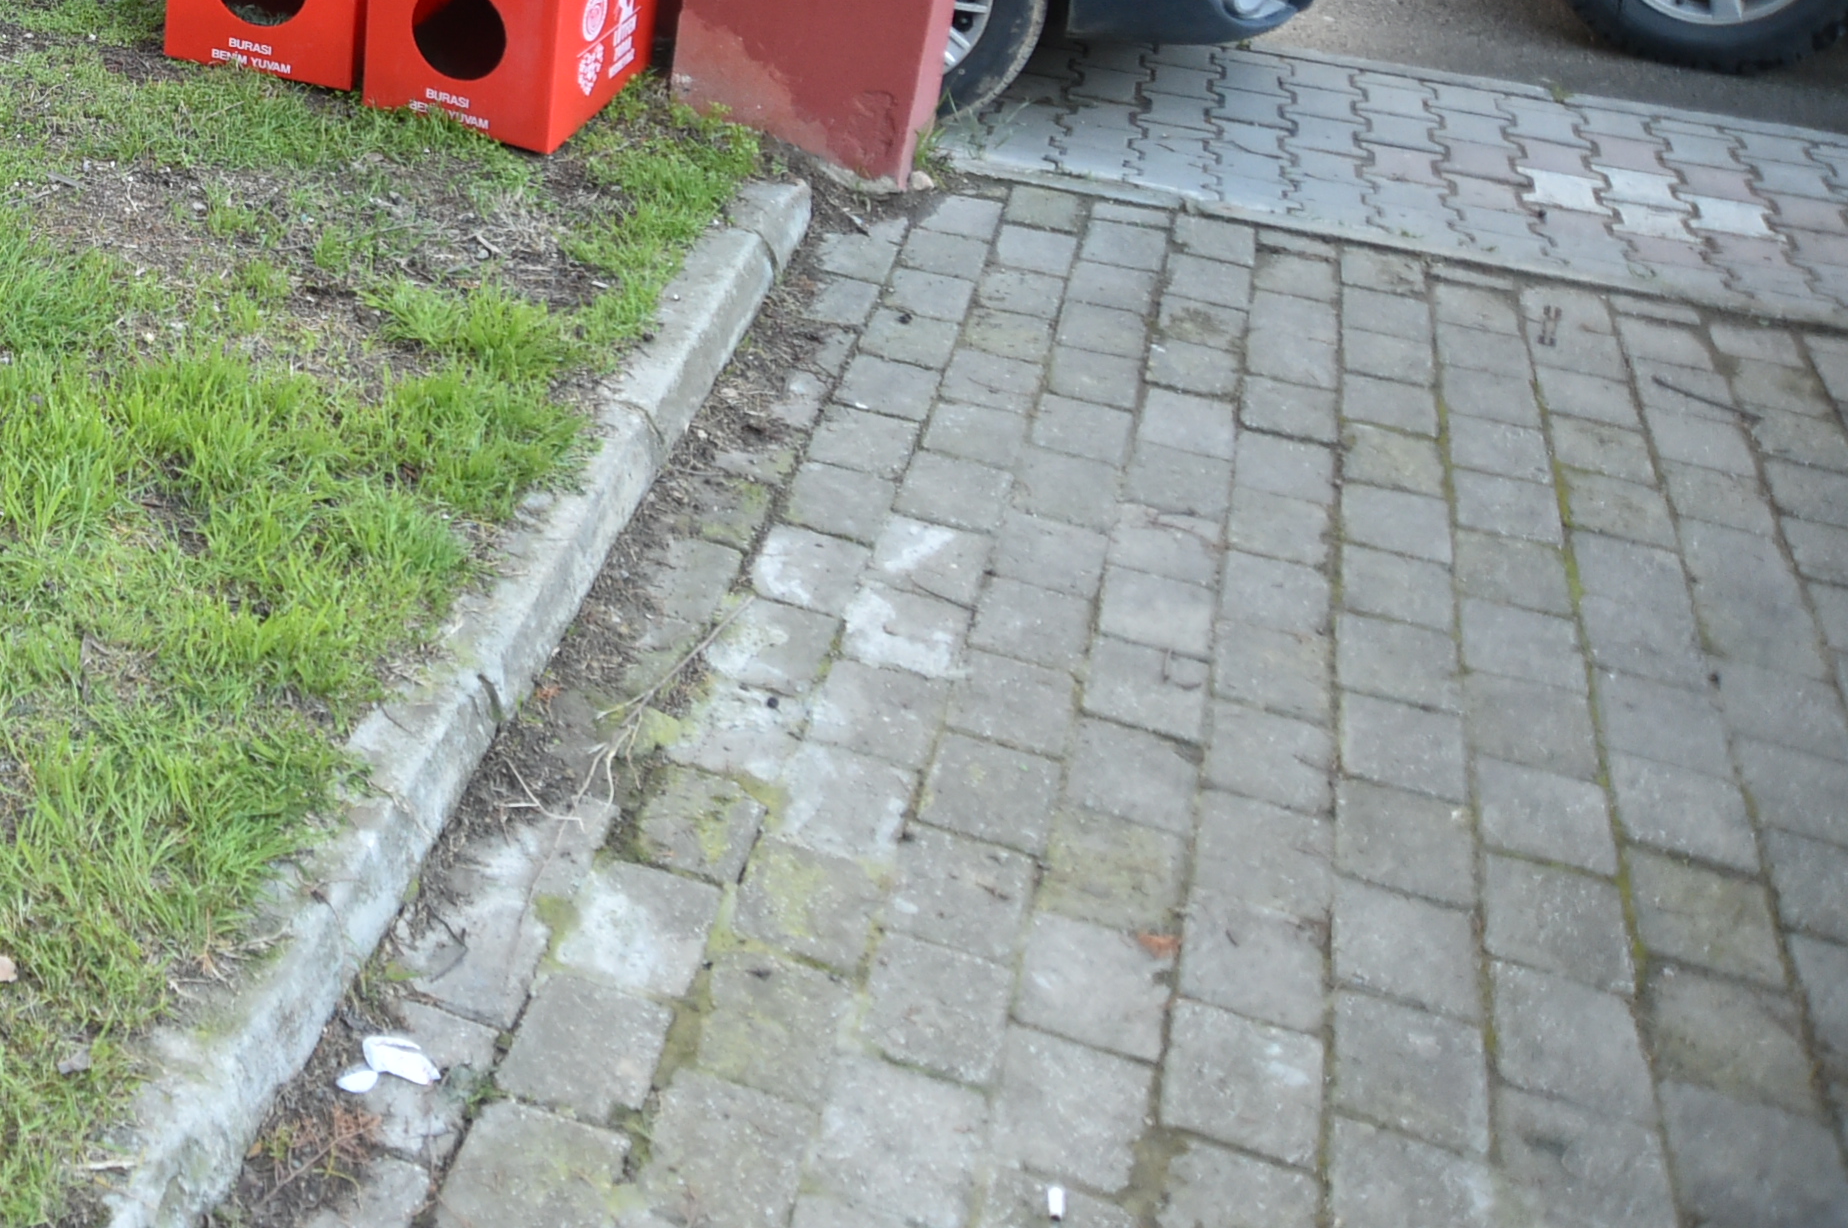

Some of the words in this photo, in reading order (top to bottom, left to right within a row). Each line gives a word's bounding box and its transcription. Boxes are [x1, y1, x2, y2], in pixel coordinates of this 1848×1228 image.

[228, 37, 272, 56] BURASI
[250, 56, 291, 74] YUVAM
[425, 87, 470, 109] BURASI
